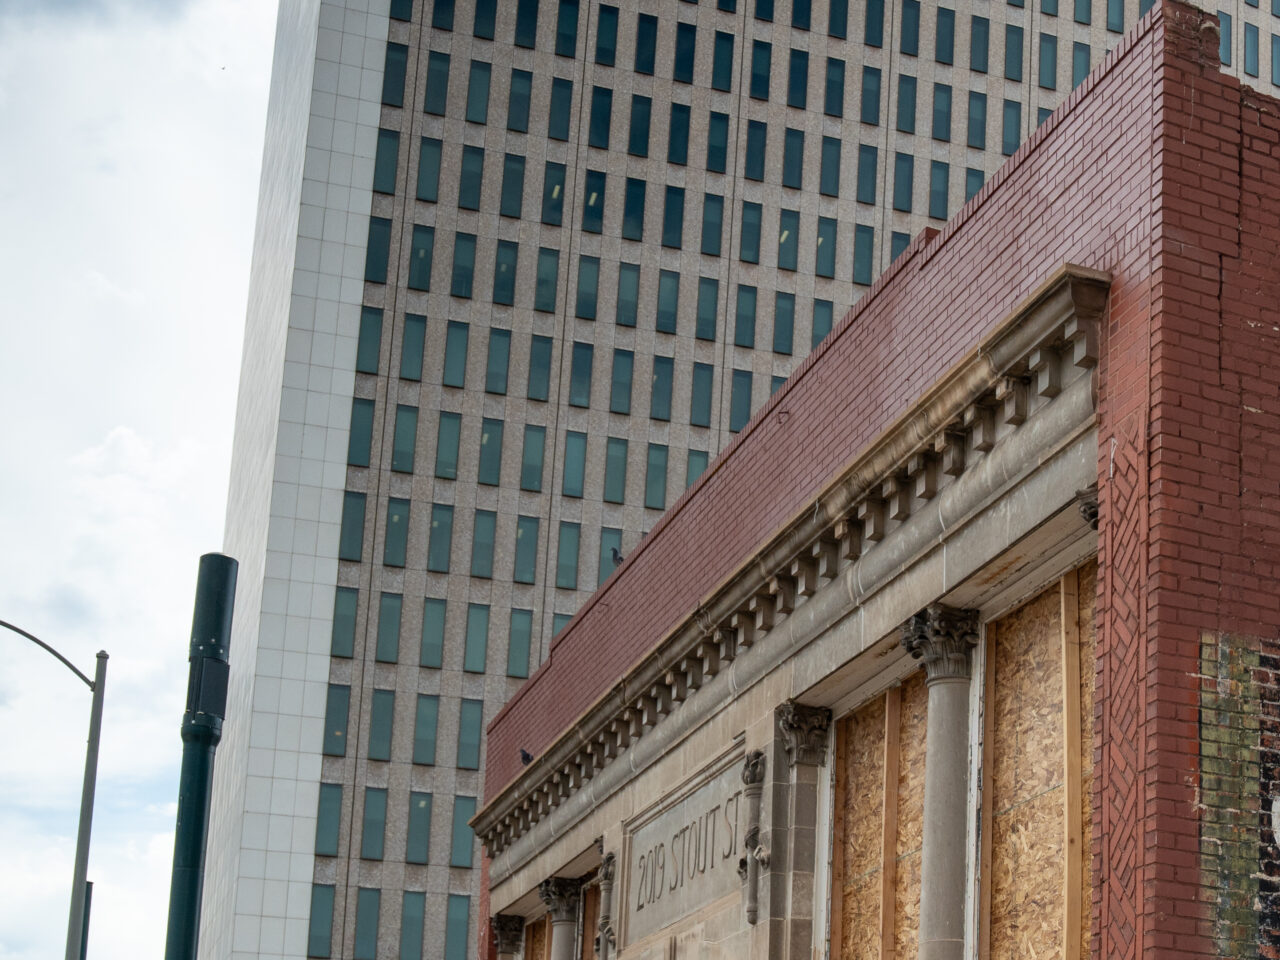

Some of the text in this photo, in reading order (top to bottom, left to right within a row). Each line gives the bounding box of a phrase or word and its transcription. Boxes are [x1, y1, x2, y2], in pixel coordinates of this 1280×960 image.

[636, 789, 743, 912] 2019 STOUT ST
